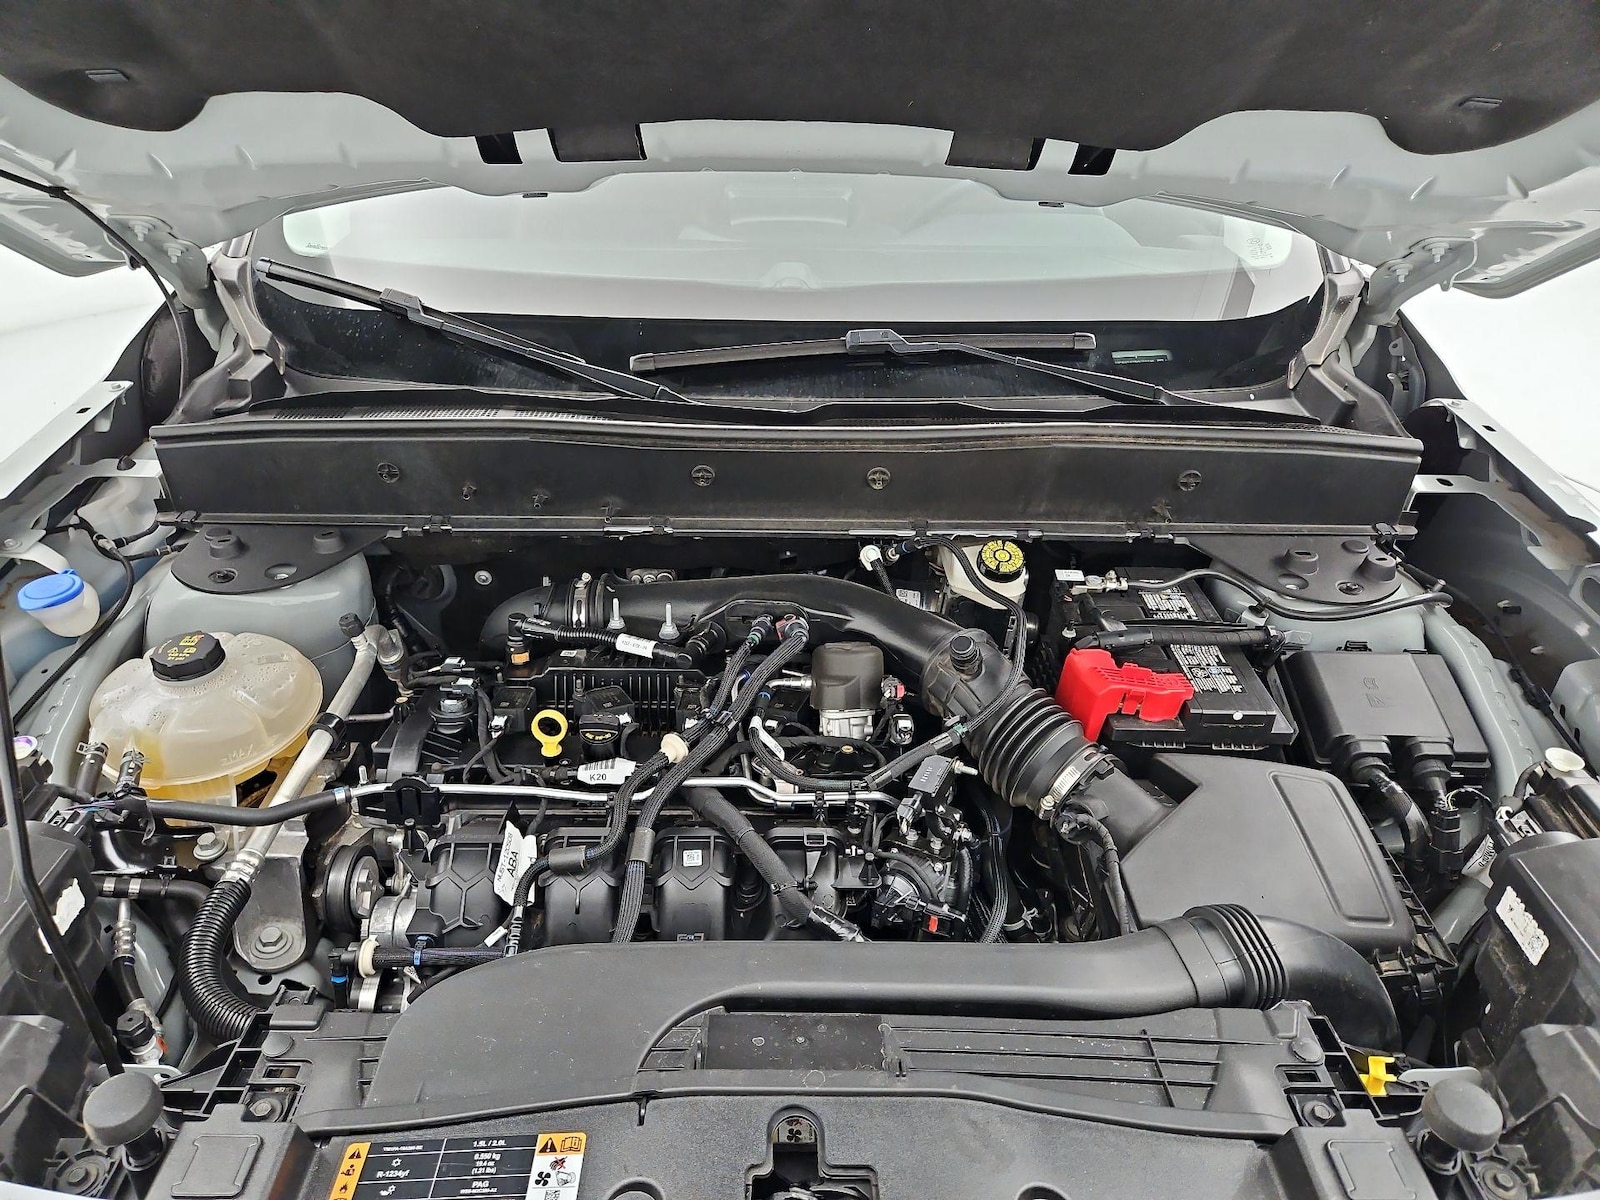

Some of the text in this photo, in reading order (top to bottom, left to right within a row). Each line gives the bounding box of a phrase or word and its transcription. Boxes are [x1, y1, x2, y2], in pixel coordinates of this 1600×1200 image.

[589, 773, 607, 781] K20
[506, 851, 519, 878] ABA
[376, 1169, 411, 1178] R-1234yf
